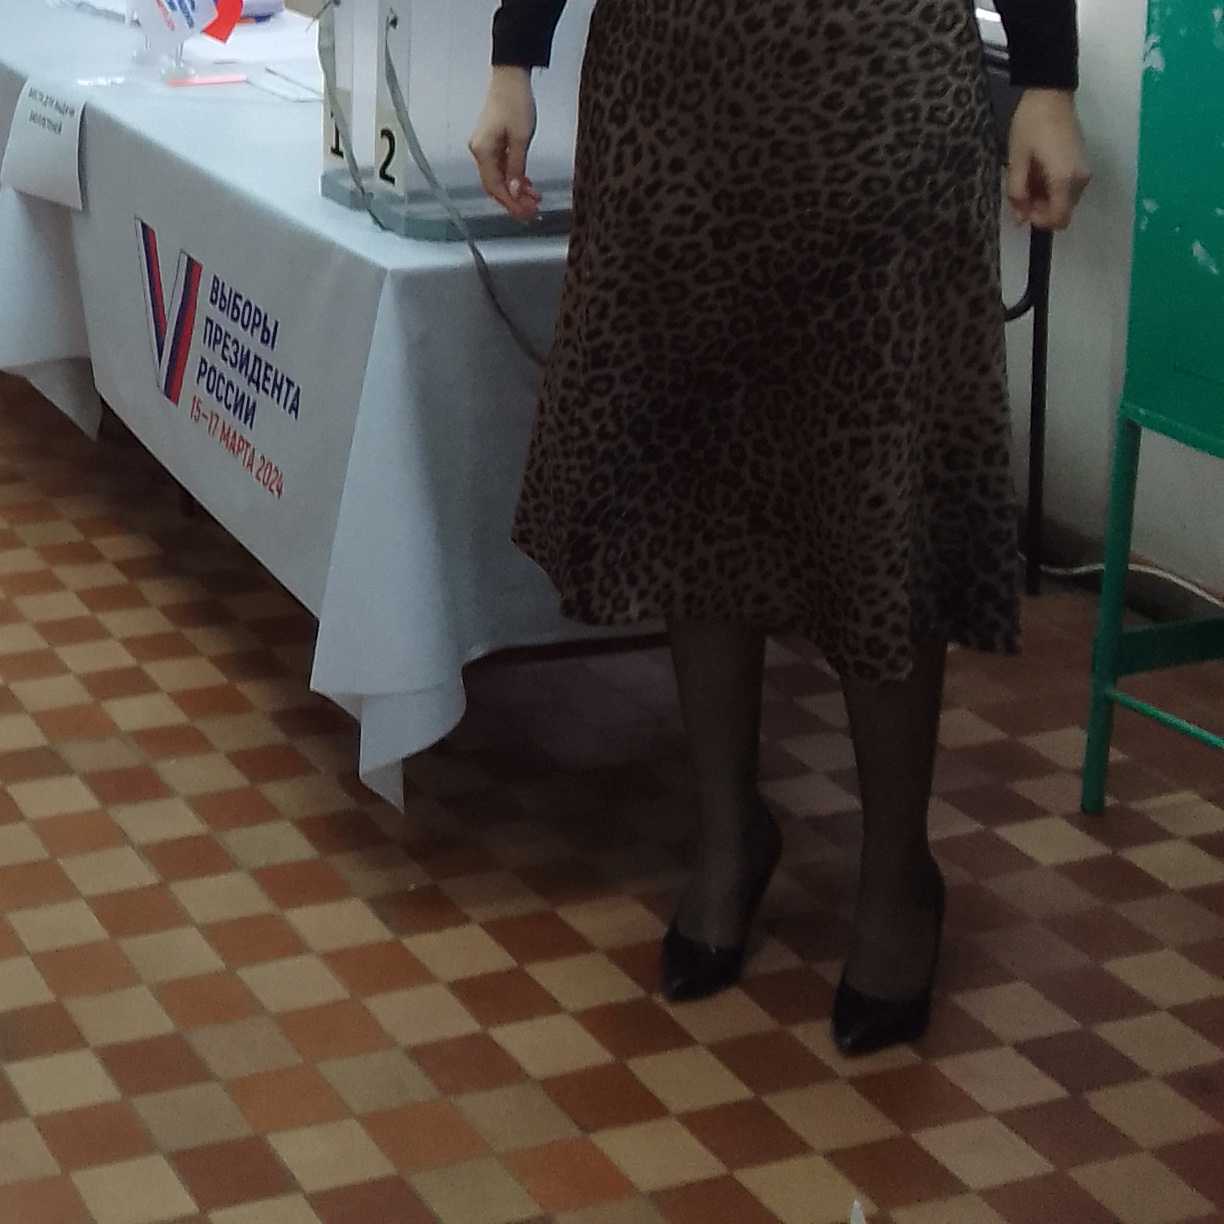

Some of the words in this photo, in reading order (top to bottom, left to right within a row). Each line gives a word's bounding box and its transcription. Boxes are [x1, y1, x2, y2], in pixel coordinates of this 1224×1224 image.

[379, 128, 396, 186] 2
[209, 274, 279, 351] ВЫБОРЫ
[196, 355, 258, 430] РОССИИ
[202, 315, 302, 421] ПРЕЗИДЕНТА
[219, 422, 256, 474] МАРТА
[255, 454, 284, 500] 2024
